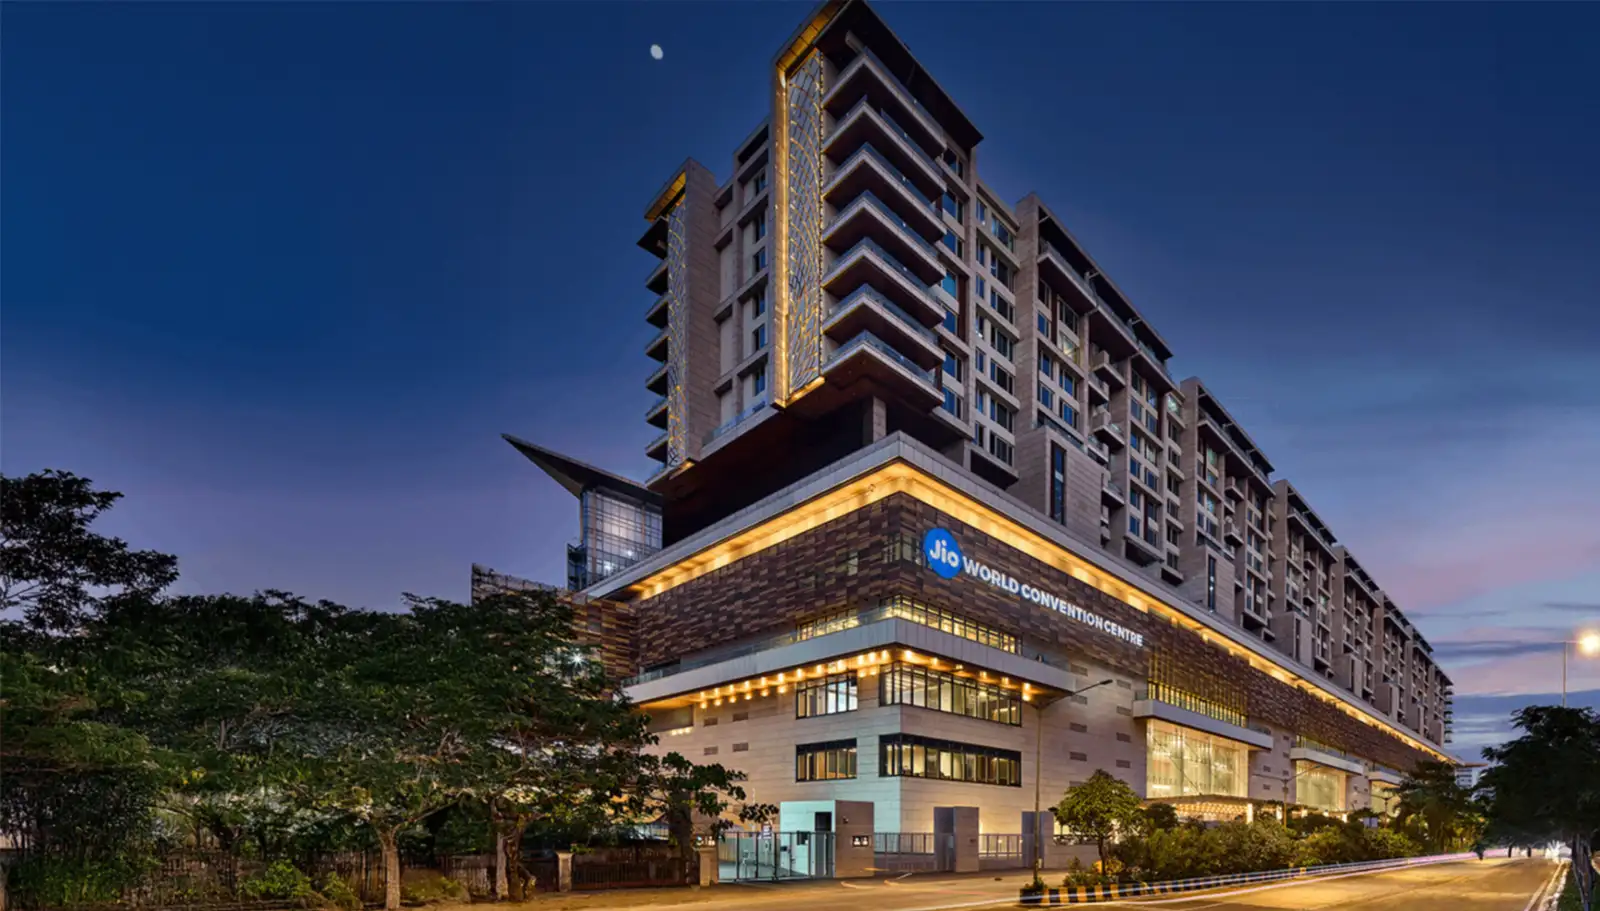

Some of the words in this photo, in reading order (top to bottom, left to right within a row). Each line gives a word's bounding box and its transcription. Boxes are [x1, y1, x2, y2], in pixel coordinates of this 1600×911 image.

[929, 540, 959, 568] Jio
[962, 555, 1020, 594] WORLD
[1020, 584, 1103, 629] CONVENTION
[1103, 621, 1143, 646] CENTRE
